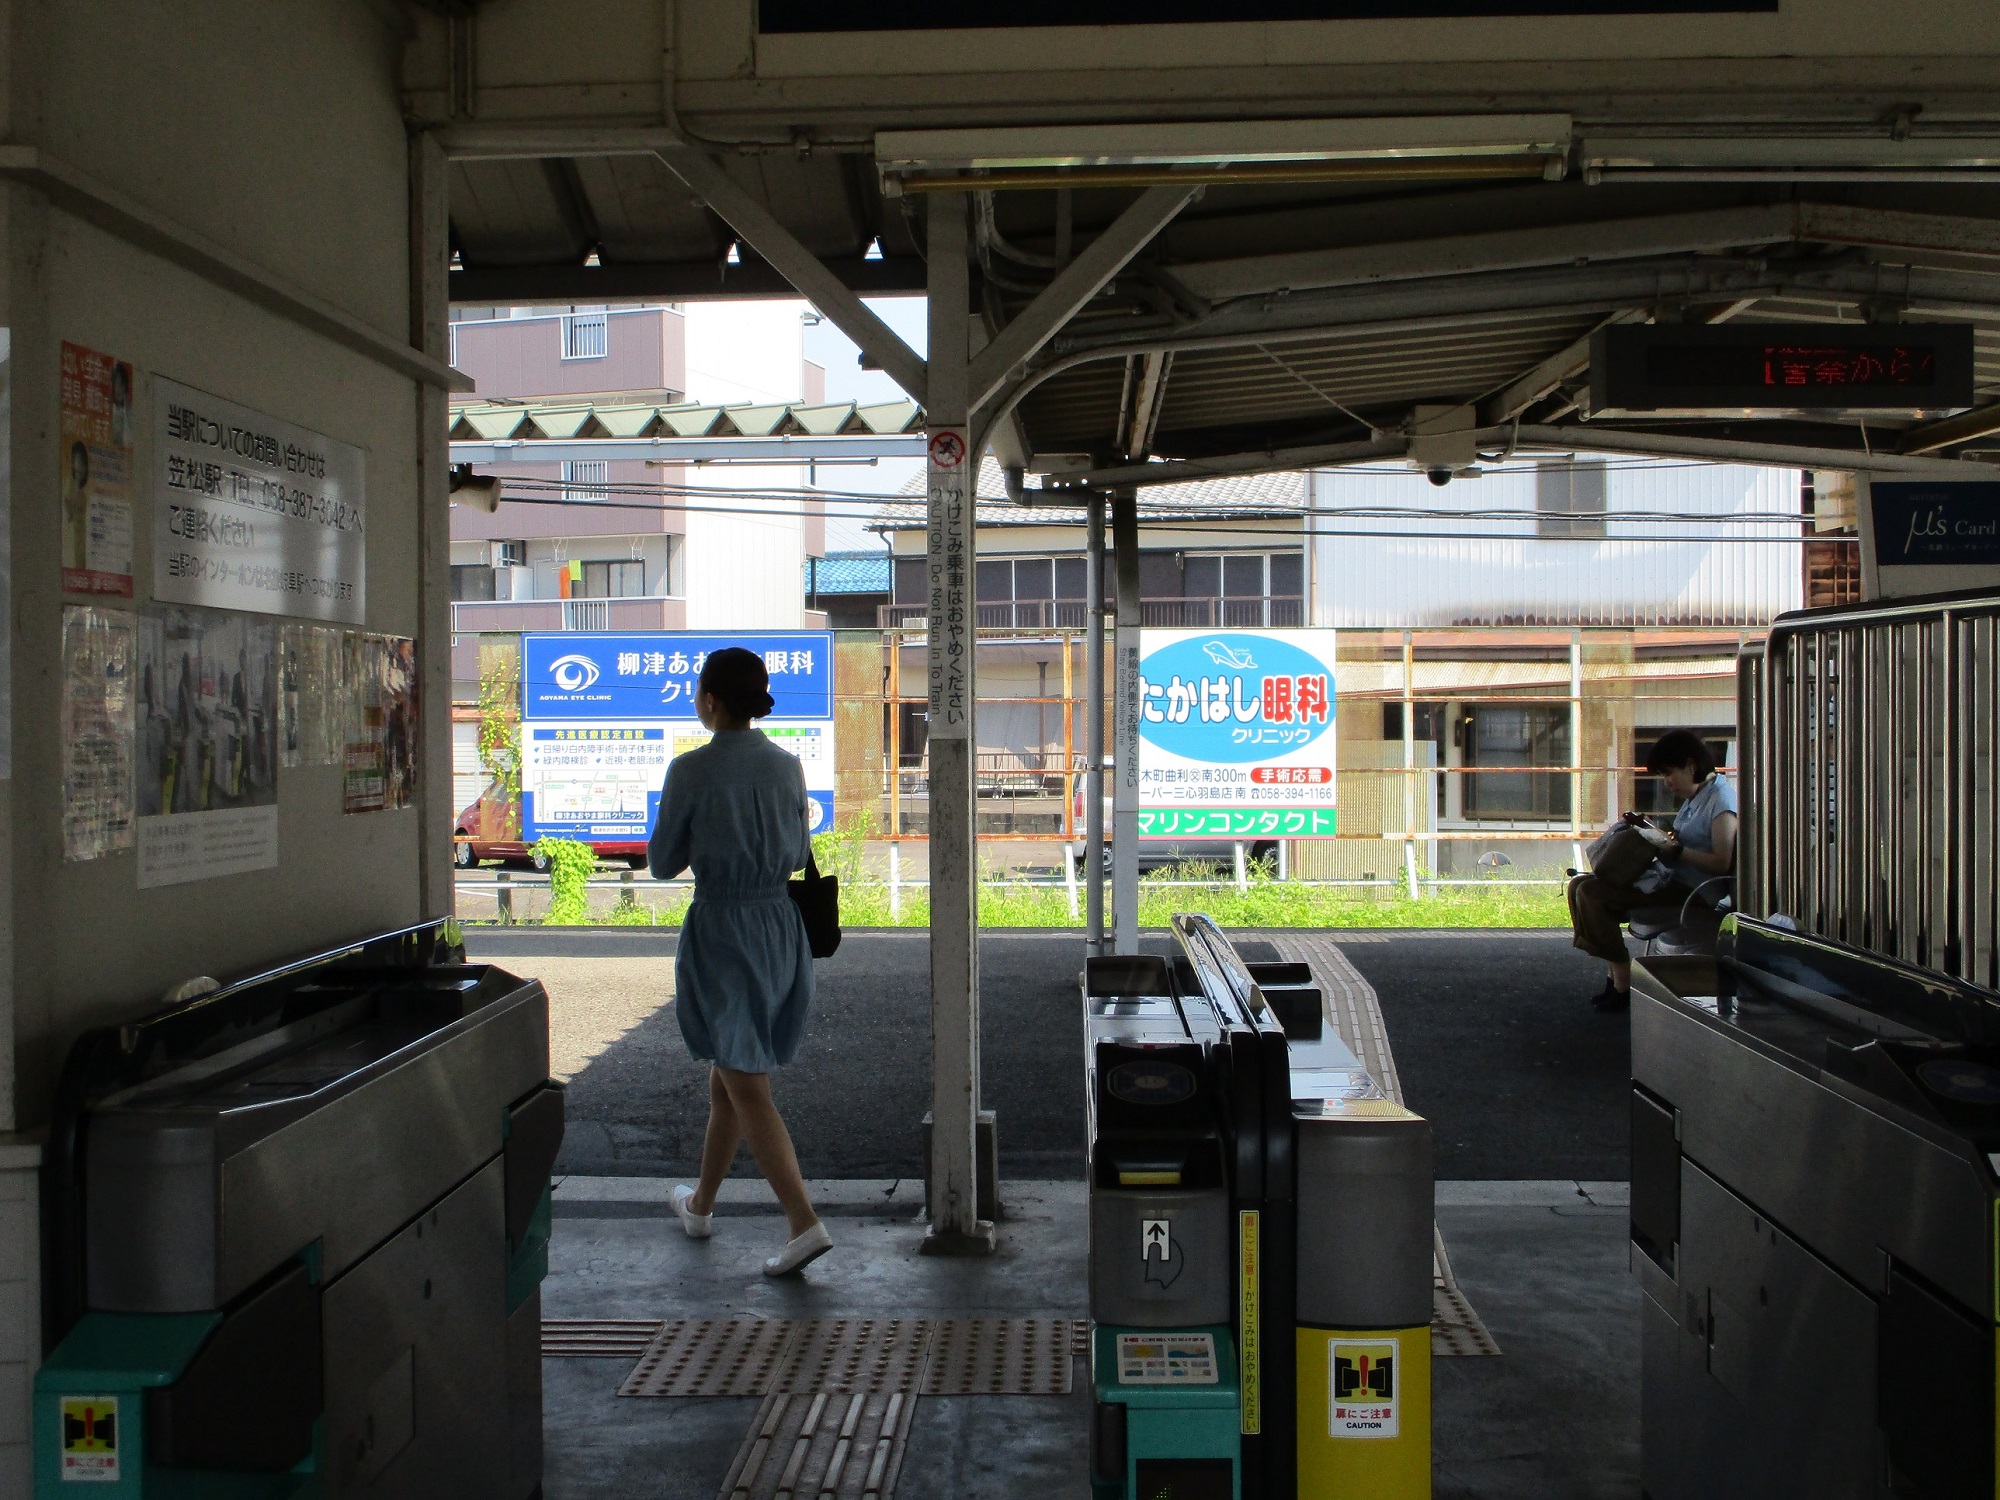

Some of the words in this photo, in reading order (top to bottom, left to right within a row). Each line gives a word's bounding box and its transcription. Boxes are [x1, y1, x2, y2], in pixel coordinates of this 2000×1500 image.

[168, 404, 326, 479] 当駅についてのお問い合わせは
[168, 454, 222, 496] 笠松駅
[168, 505, 255, 549] ご連絡ください
[1954, 520, 1997, 536] Card
[931, 564, 942, 583] Do
[931, 587, 942, 612] Not
[947, 488, 964, 724] かけこみ乗車はおやめください
[931, 616, 942, 643] Run
[617, 650, 814, 676] 柳津あお眼科
[1119, 647, 1127, 668] Stay
[931, 662, 942, 678] To
[1119, 669, 1127, 698] Behind
[931, 682, 942, 716] Train
[1119, 699, 1127, 726] Yellow
[555, 730, 645, 739] 先進医療認定施設
[1119, 727, 1127, 746] Line
[1231, 728, 1311, 745] クリニック
[543, 756, 588, 765] 緑内障検診
[605, 756, 664, 765] 近視・老眼治療
[1260, 768, 1323, 783] 手術応需
[1261, 787, 1332, 799] 058-394-1166
[1138, 811, 1330, 834] マリンコンタクト
[1335, 1408, 1392, 1419] 扉にご注意
